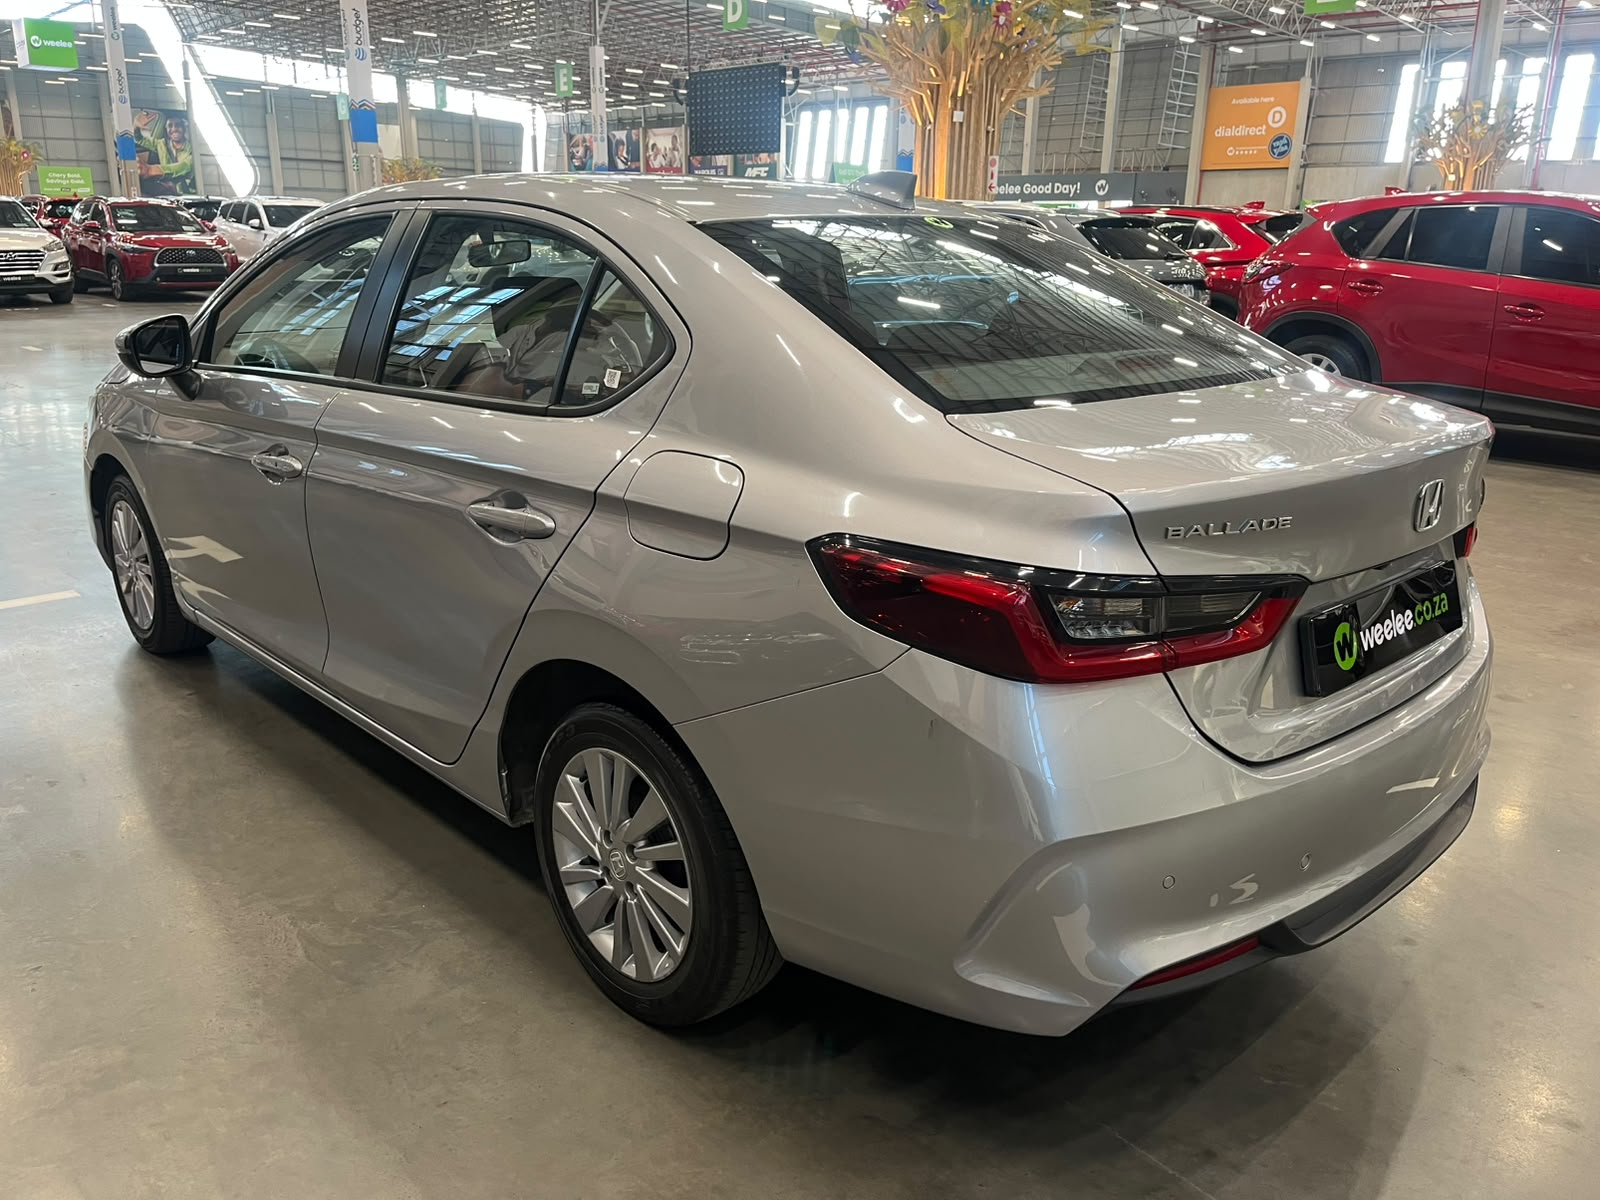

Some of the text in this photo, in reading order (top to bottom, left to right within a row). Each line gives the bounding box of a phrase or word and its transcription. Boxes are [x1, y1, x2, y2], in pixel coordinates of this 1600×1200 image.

[727, 0, 743, 23] D
[352, 8, 364, 46] budget
[43, 39, 73, 48] weelee
[559, 68, 569, 92] E
[1231, 97, 1260, 105] Available
[1214, 124, 1266, 137] dialdirect
[744, 166, 769, 177] MFC
[1022, 182, 1052, 194] Good
[1054, 181, 1081, 197] Day!
[1166, 516, 1293, 539] BALLADE
[1360, 592, 1449, 651] weelee.co.za
